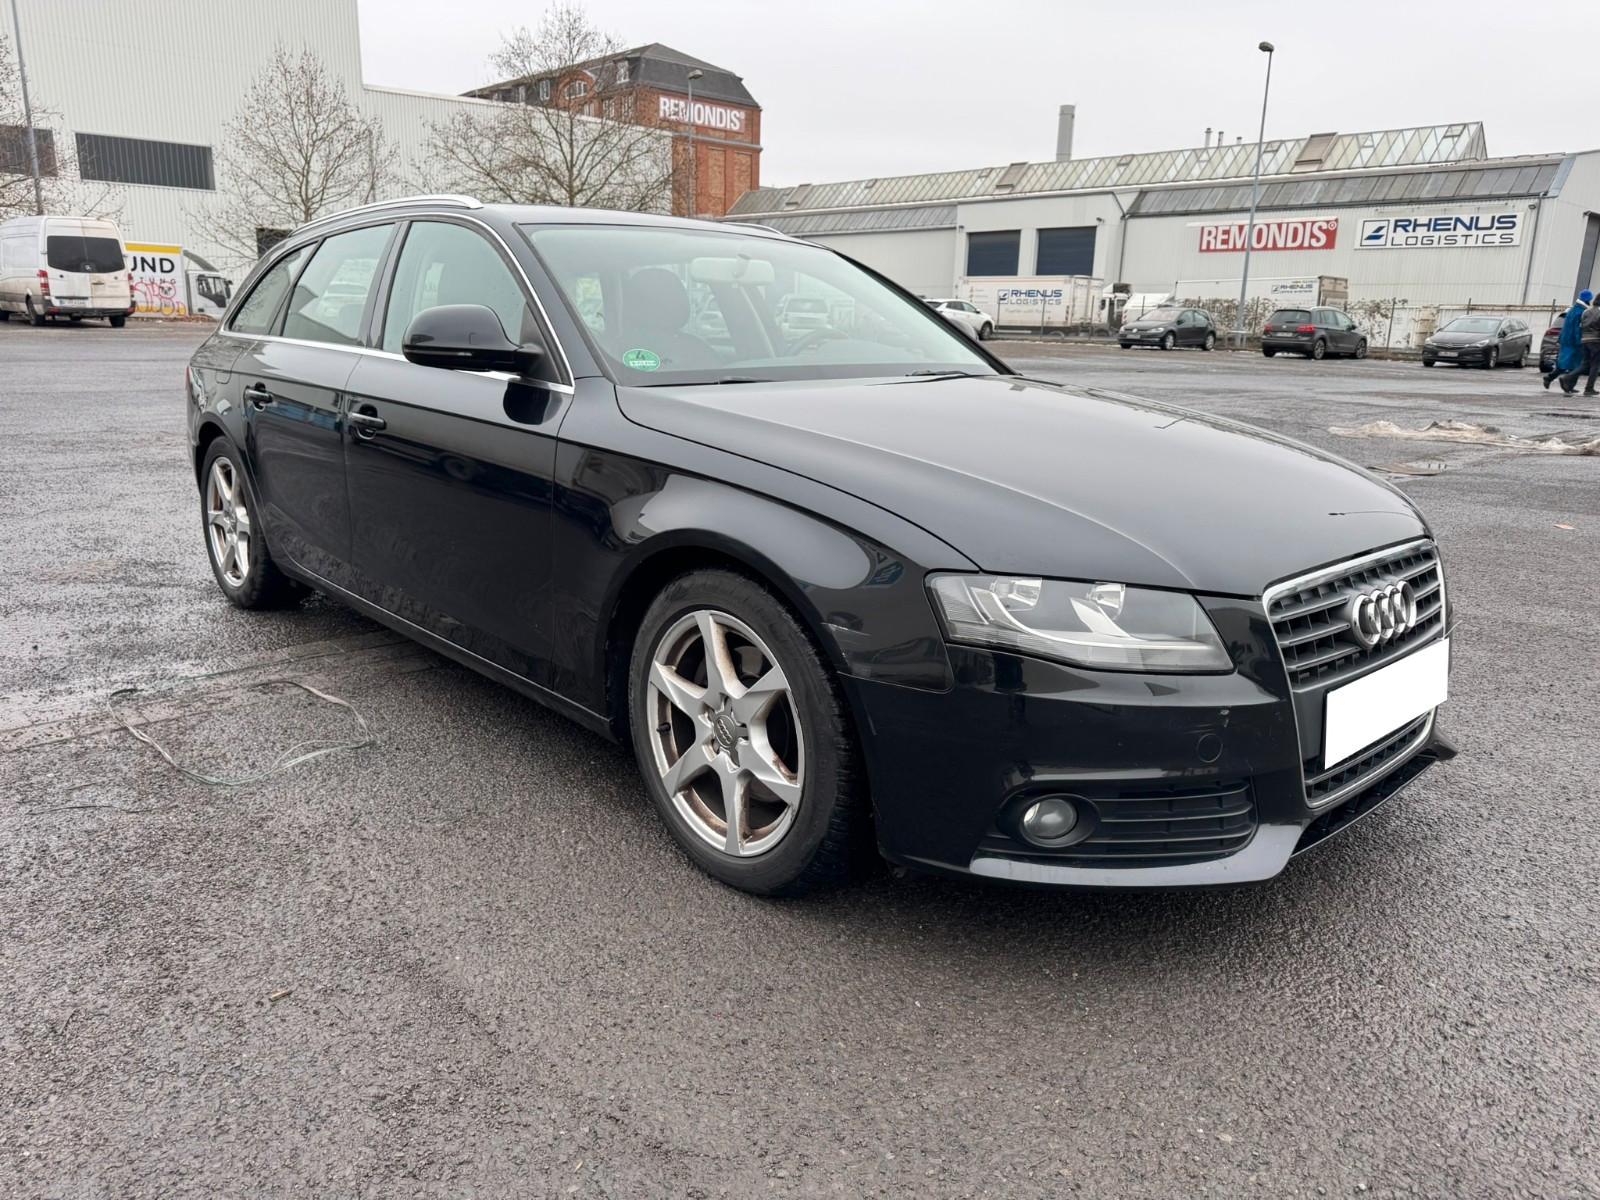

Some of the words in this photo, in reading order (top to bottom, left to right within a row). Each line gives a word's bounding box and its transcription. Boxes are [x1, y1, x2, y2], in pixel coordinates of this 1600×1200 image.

[1393, 214, 1517, 233] RHENUS
[1391, 233, 1514, 246] LOGISTICS
[1010, 289, 1063, 298] RHENUS
